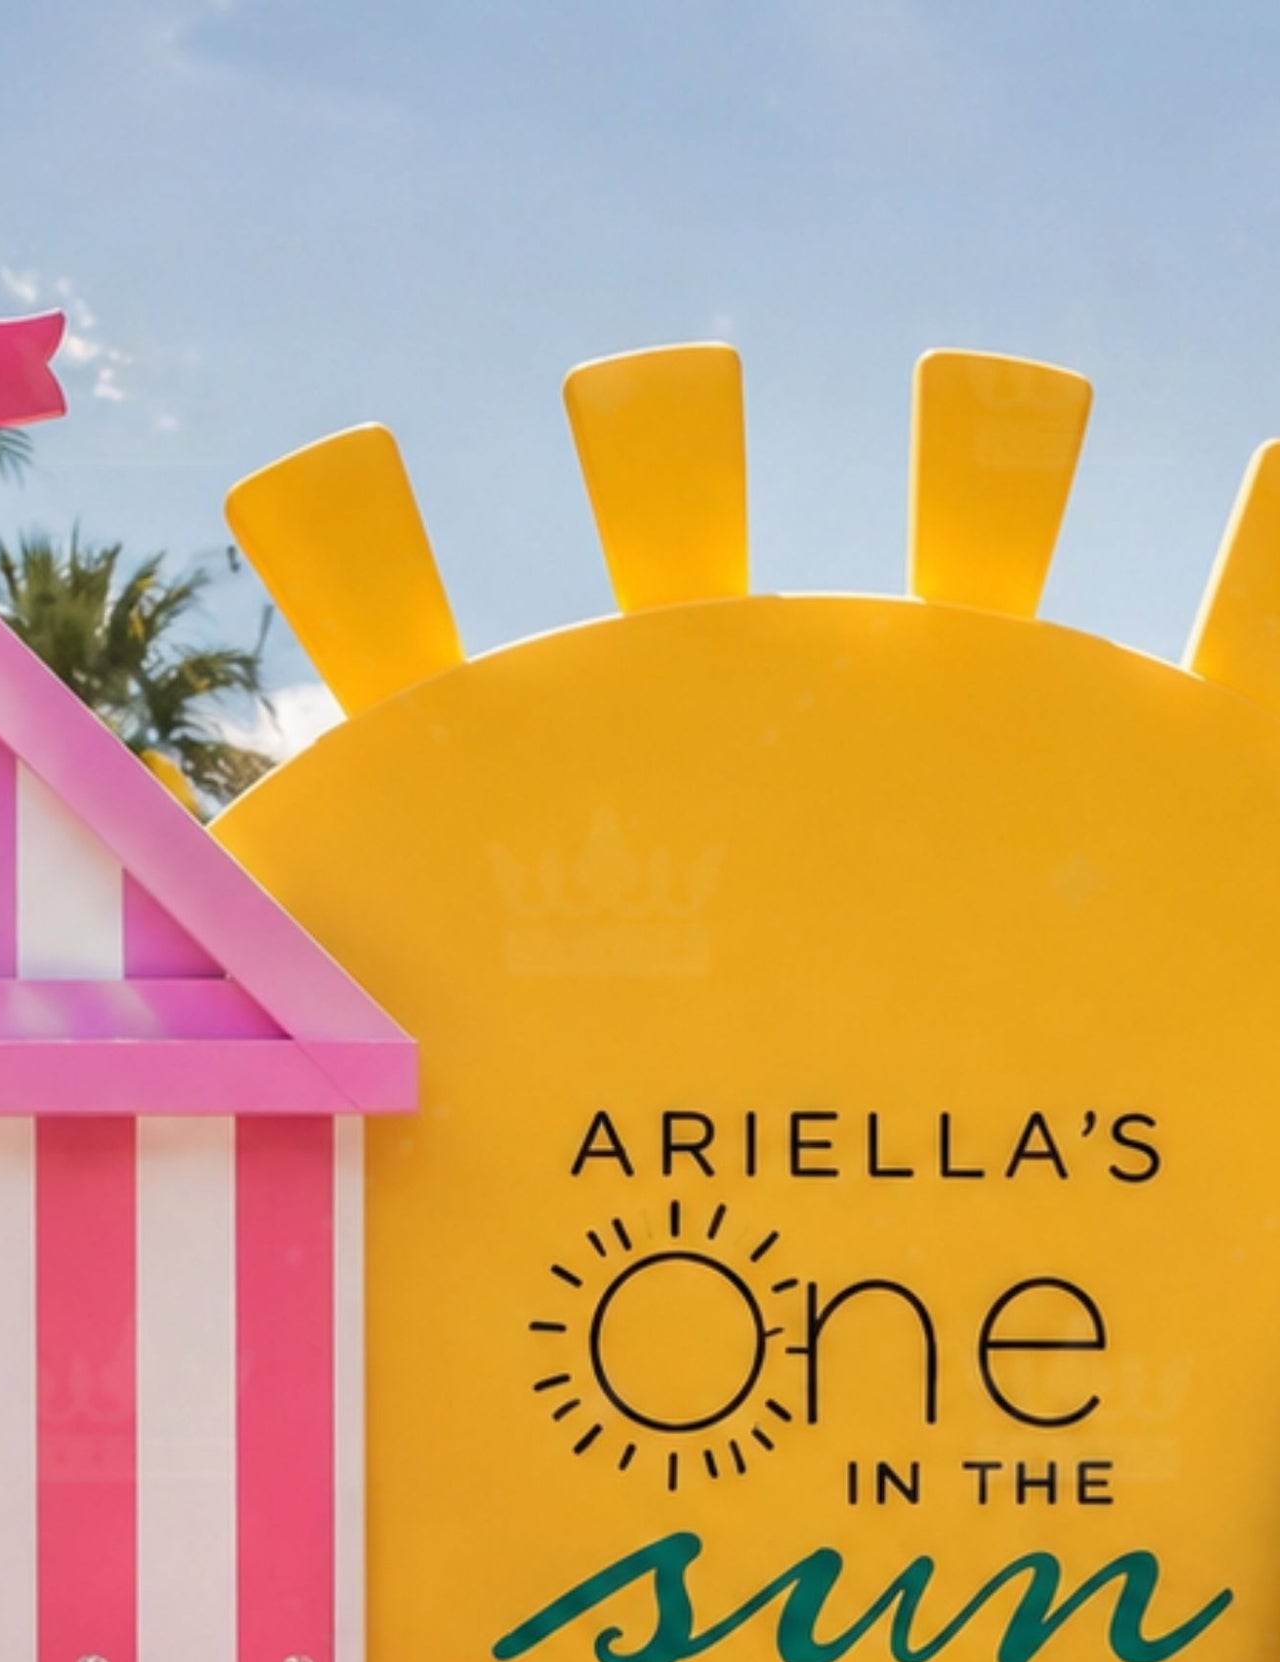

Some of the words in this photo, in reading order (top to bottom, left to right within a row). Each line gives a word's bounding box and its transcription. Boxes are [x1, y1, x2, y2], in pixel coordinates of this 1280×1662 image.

[569, 1109, 1162, 1185] ARIELLA'S
[588, 1249, 1107, 1431] One
[846, 1460, 921, 1505] IN
[961, 1460, 1115, 1505] THE
